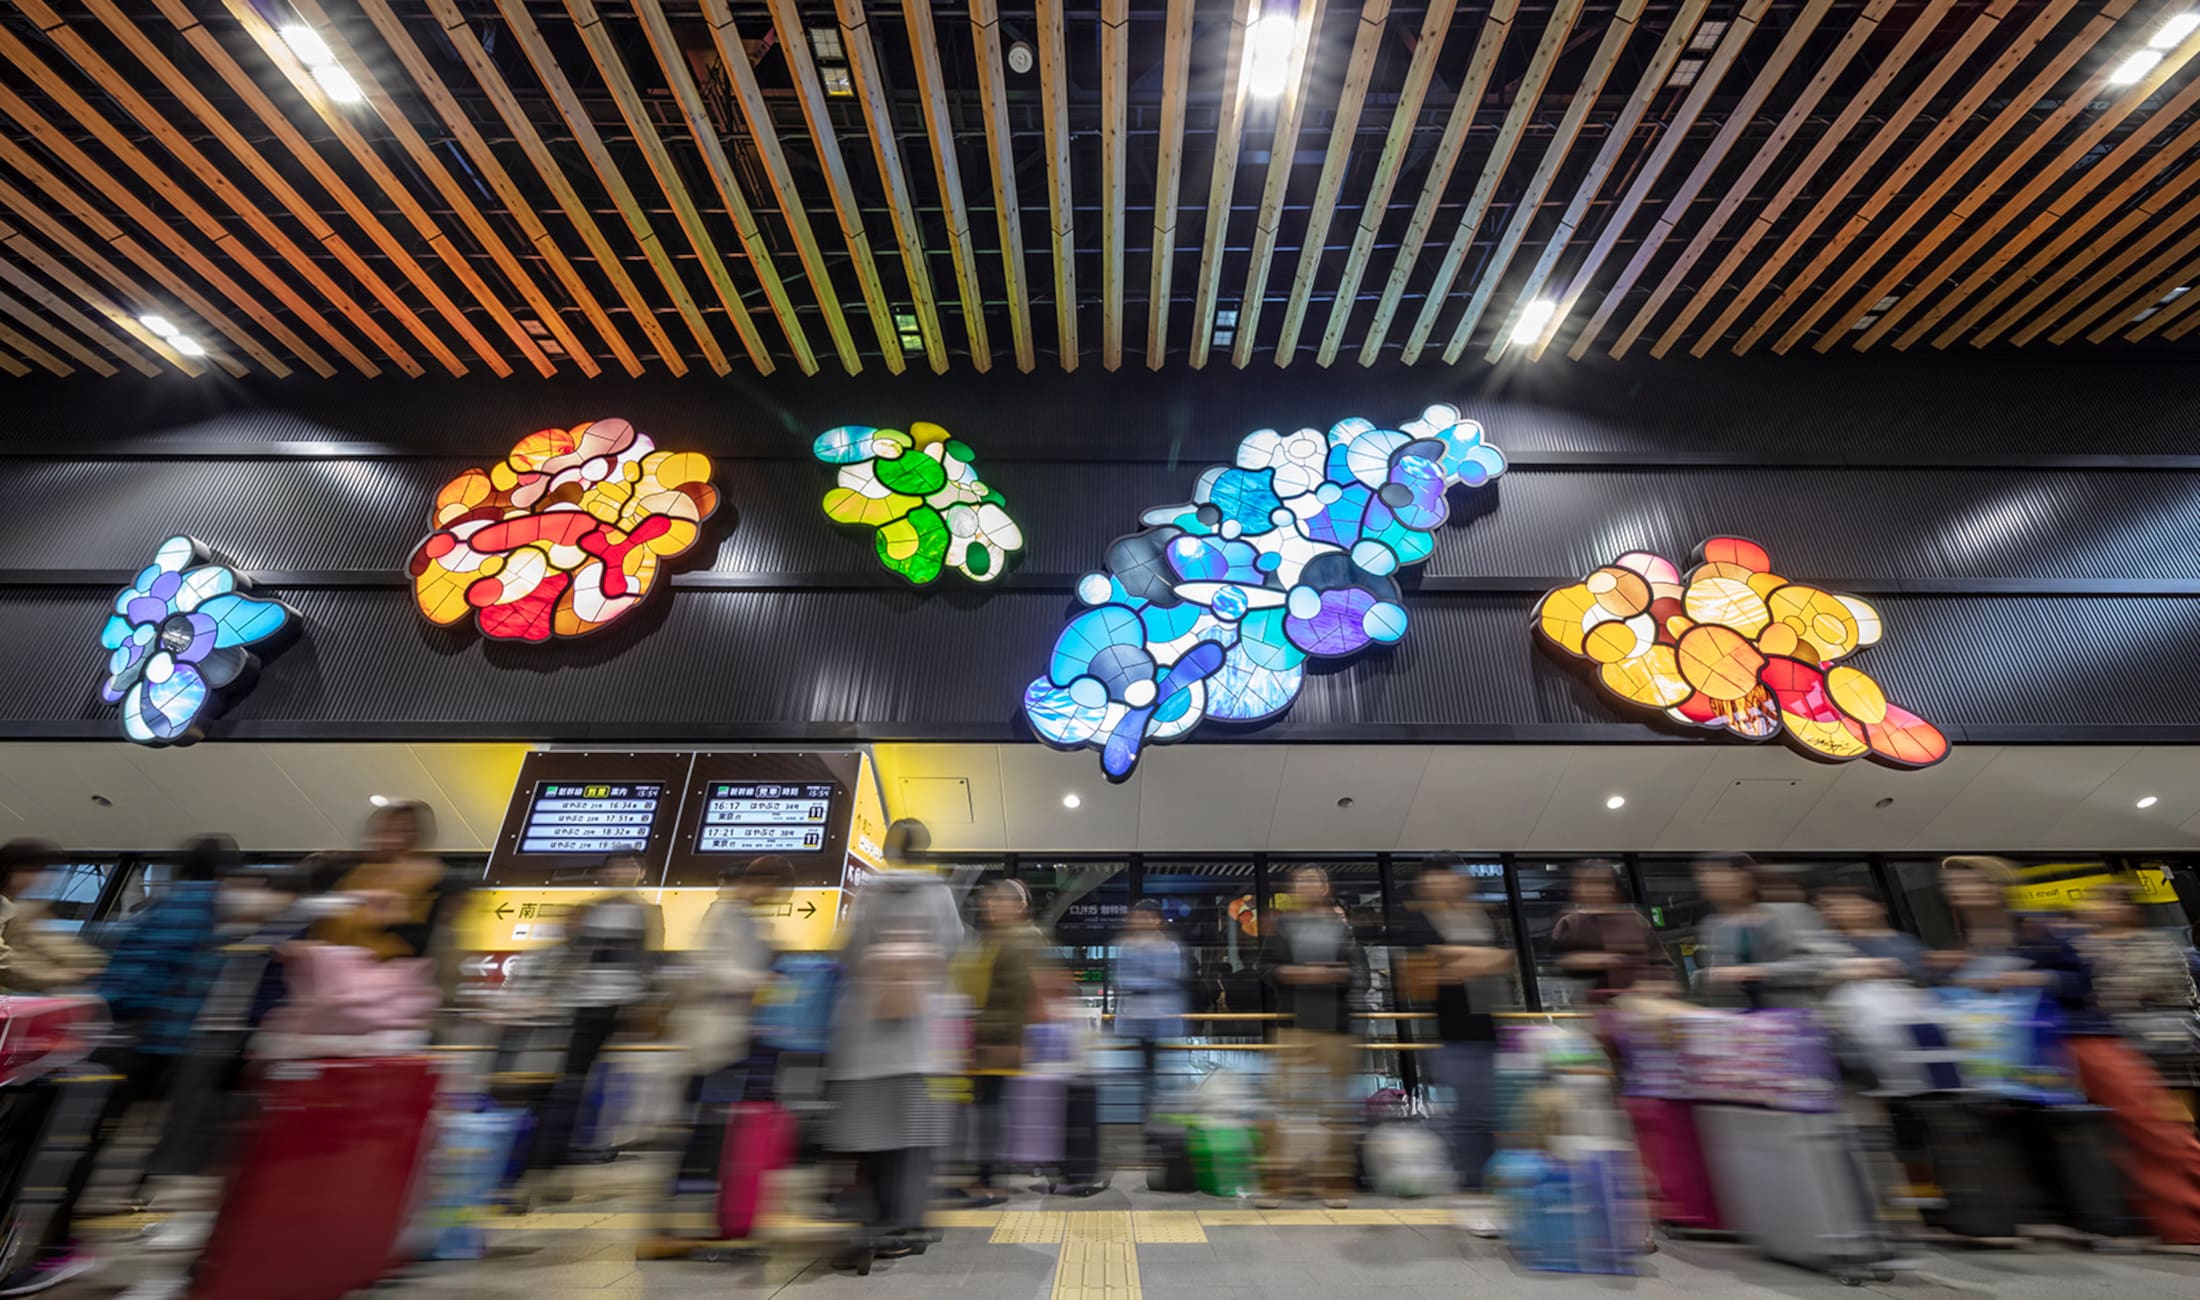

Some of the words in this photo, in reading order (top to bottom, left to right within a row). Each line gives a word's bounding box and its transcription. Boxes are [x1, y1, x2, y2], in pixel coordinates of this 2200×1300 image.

[714, 802, 741, 810] 16:17
[750, 802, 780, 810] はやぶさ
[708, 828, 734, 836] 17:21
[744, 828, 775, 836] はやぶさ
